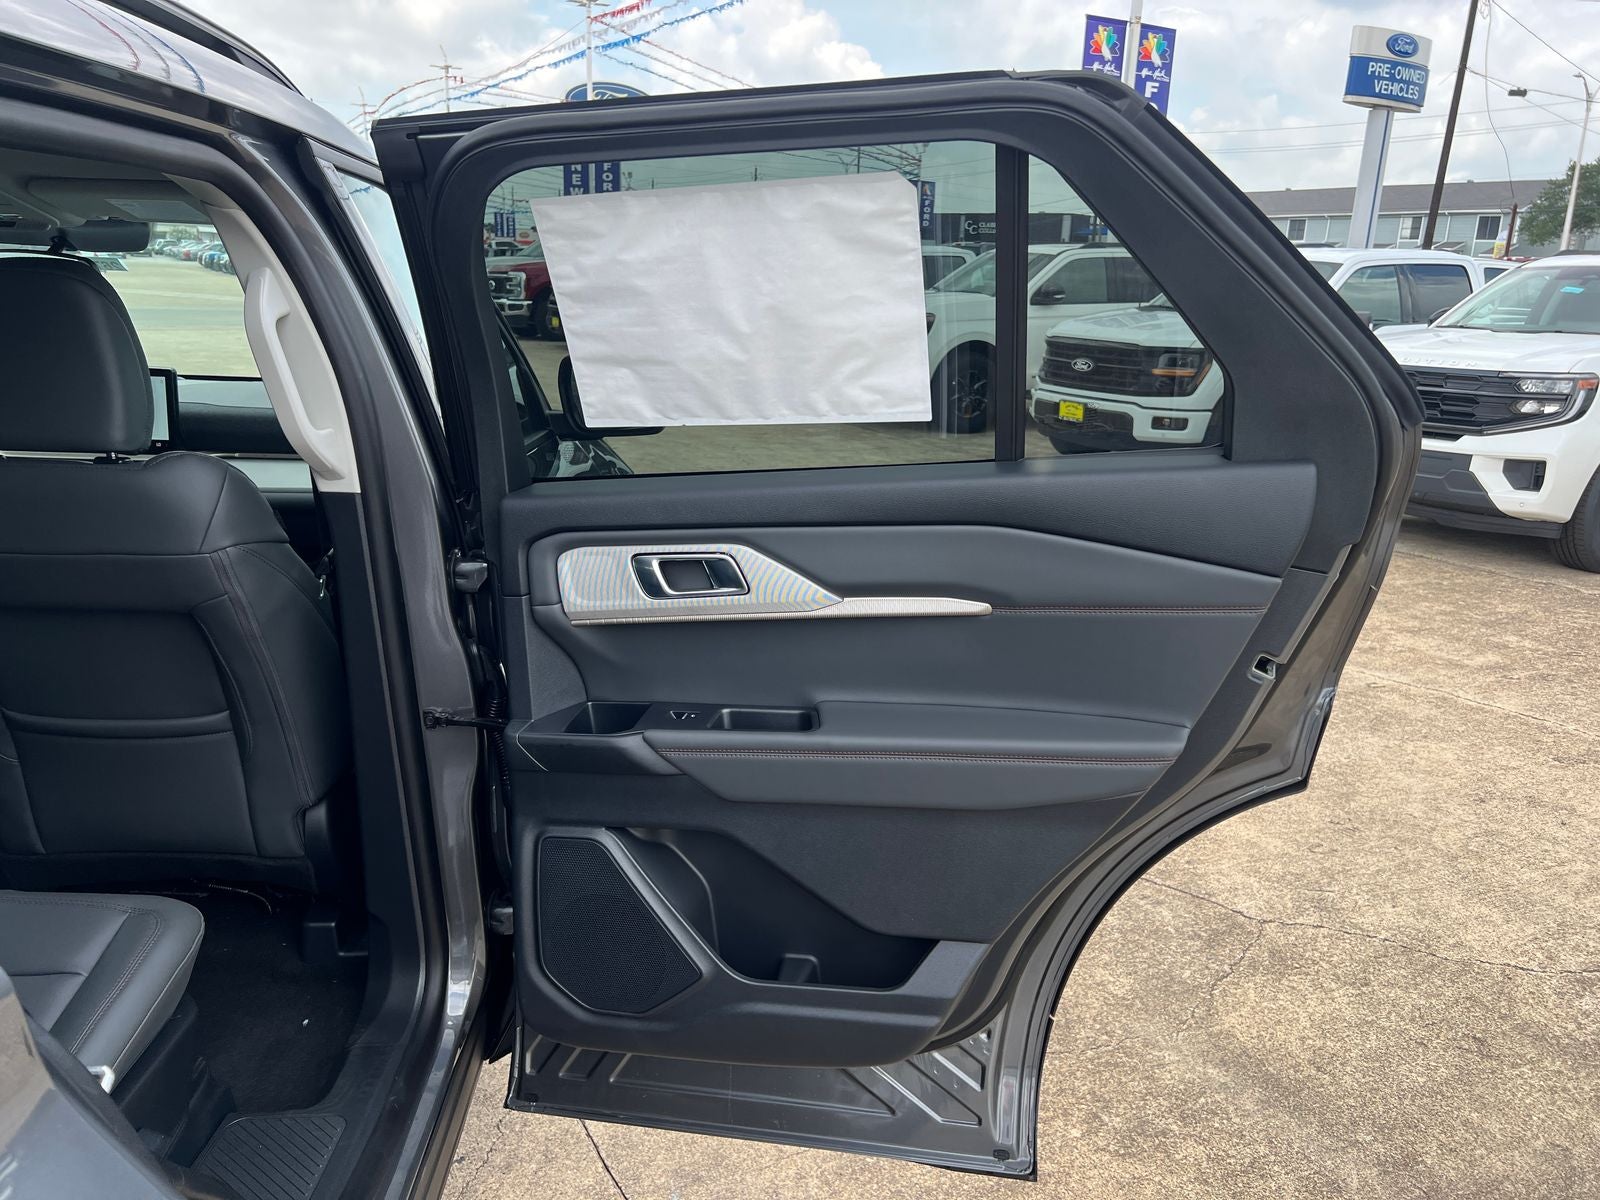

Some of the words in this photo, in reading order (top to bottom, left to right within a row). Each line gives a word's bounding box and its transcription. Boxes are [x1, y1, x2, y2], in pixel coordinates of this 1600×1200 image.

[1395, 37, 1415, 54] Ford
[1368, 62, 1426, 85] PRE-OWNED
[1374, 80, 1420, 99] VEHICLES
[570, 164, 584, 195] NEW
[922, 200, 932, 227] FORD
